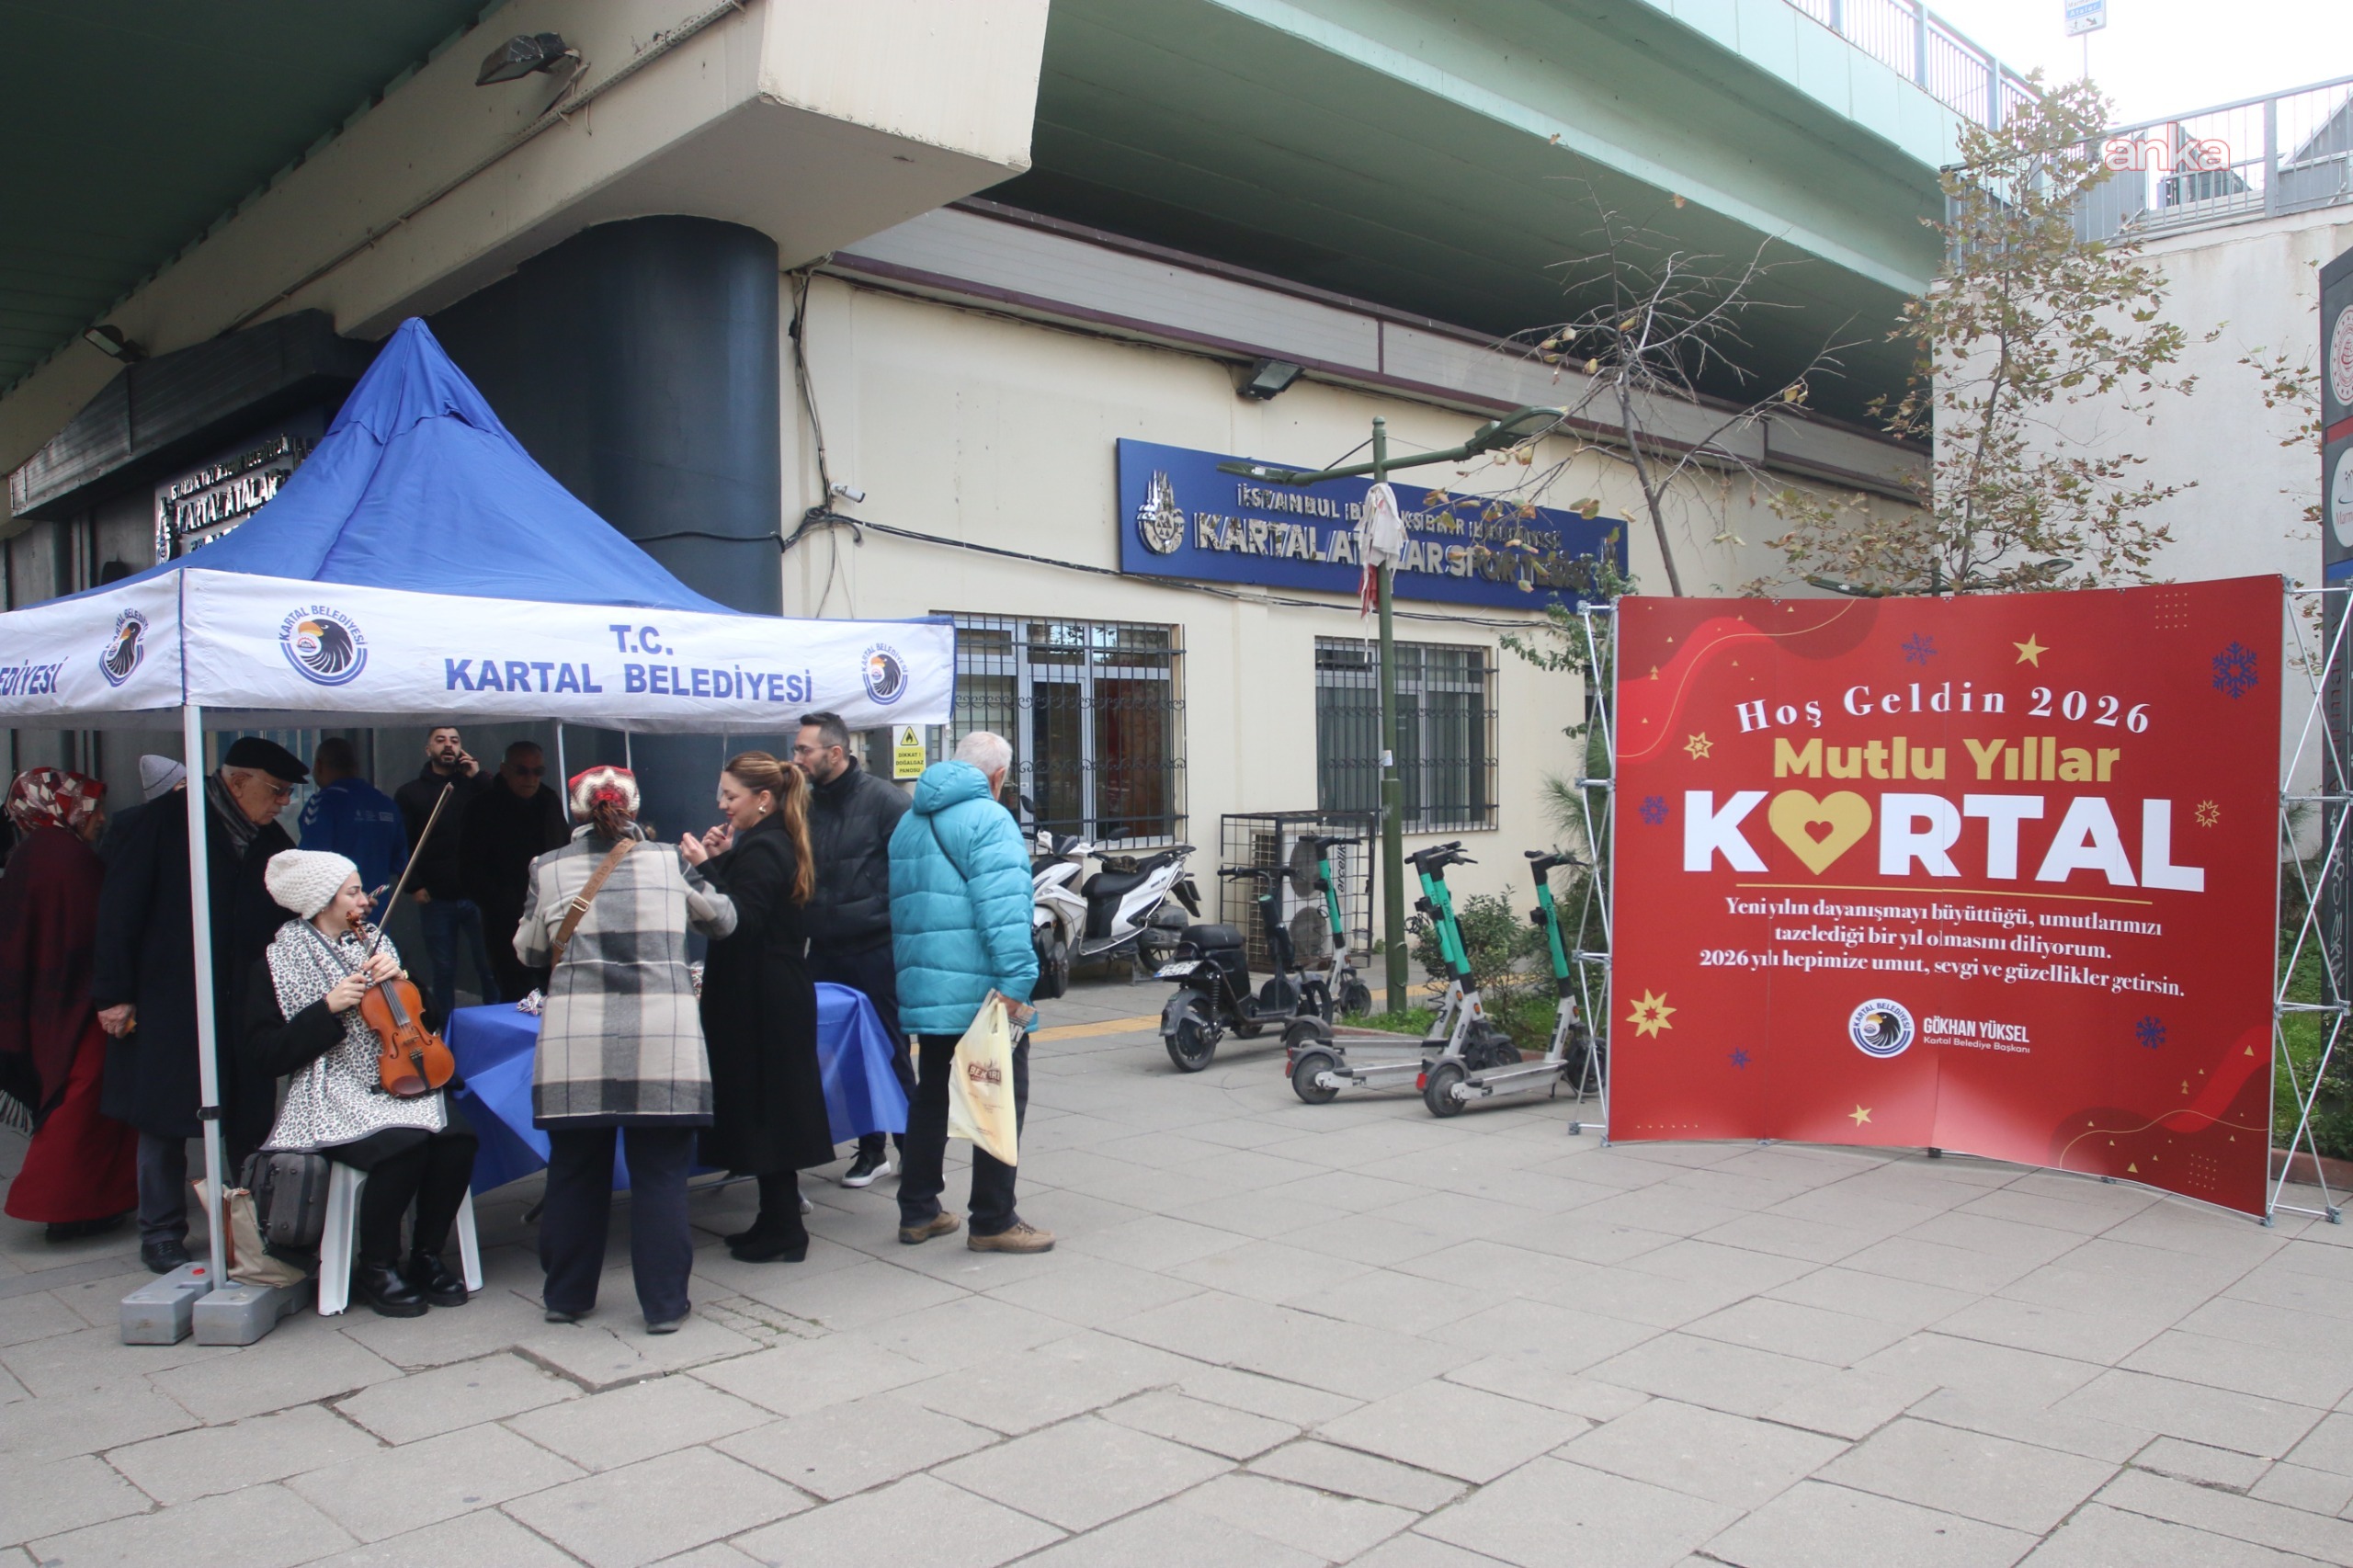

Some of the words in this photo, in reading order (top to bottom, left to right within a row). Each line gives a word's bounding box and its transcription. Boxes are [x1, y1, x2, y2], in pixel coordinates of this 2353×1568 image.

[1193, 512, 1327, 562] KARTAL
[1446, 544, 1517, 582] SPOR
[278, 608, 310, 642] KARTAL
[311, 605, 368, 645] BELEDİYESİ
[609, 624, 674, 656] T.C.
[861, 645, 875, 672] KARTAL
[876, 642, 908, 673] BELEDİYESİ
[444, 657, 602, 694] KARTAL
[624, 663, 813, 704] BELEDİYESİ
[1734, 698, 1823, 734] Hoş
[1844, 681, 2006, 717] Geldin
[2028, 685, 2152, 734] 2026
[1774, 736, 1947, 780] Mutlu
[1962, 736, 2120, 783] Yıllar
[1725, 897, 1766, 915] Yeni
[1768, 898, 1810, 919] yılın
[1813, 899, 1928, 924] dayanışmayı
[1931, 903, 2035, 929] büyüttüğü,
[2039, 912, 2162, 937] umutlarımızı
[1775, 925, 1864, 948] tazelediği
[1868, 926, 1897, 945] bir
[1899, 928, 1923, 949] yıl
[1927, 929, 2006, 951] olmasını
[2009, 934, 2112, 960] diliyorum.
[1699, 949, 1748, 966] 2026
[1751, 949, 1779, 971] yılı
[1782, 949, 1868, 972] hepimize
[1871, 956, 1930, 975] umut,
[1934, 959, 1979, 981] sevgi
[1982, 963, 2002, 977] ve
[2005, 963, 2110, 987] güzellikler
[2110, 973, 2185, 997] getirsin.
[1853, 1005, 1875, 1027] KARTAL
[1877, 1003, 1912, 1028] BELEDİYESİ
[1924, 1016, 1976, 1037] GÖKHAN
[1979, 1020, 2029, 1043] YÜKSEL
[1953, 1038, 1992, 1050] Belediye
[1994, 1042, 2030, 1053] Başkanı
